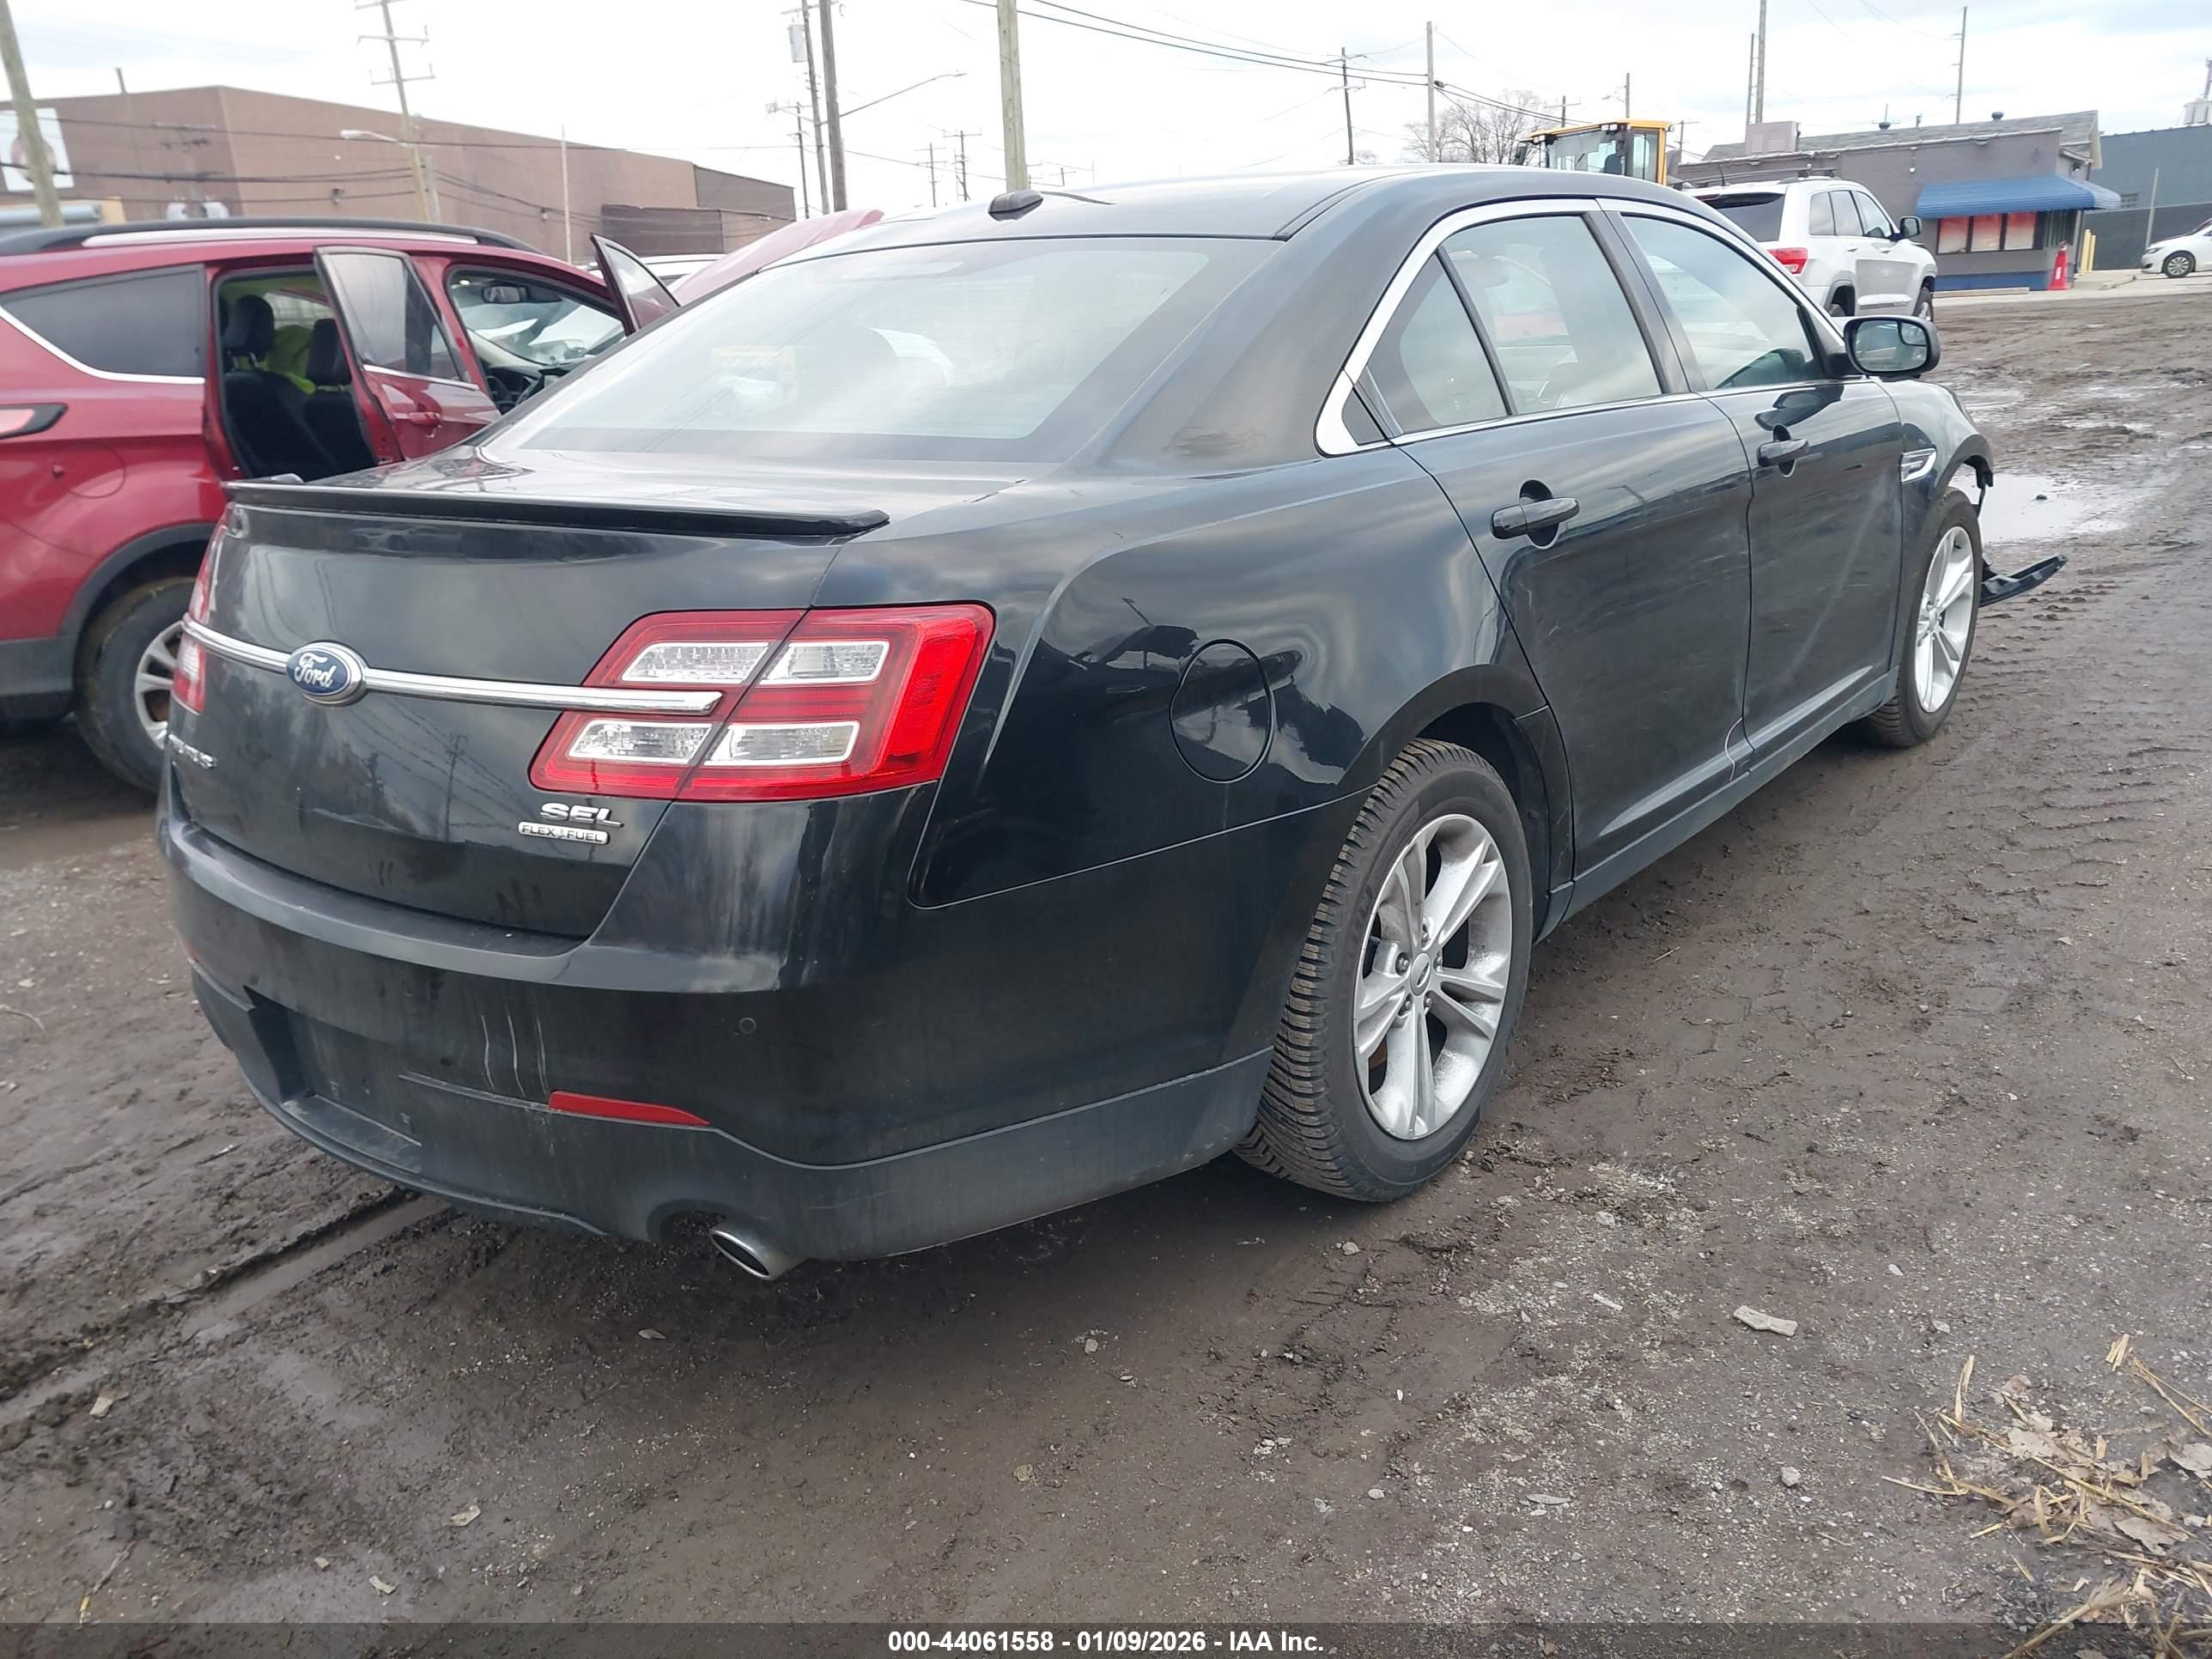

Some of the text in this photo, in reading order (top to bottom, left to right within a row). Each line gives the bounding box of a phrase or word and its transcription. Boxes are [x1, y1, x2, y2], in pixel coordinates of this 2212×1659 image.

[294, 653, 337, 688] Ford
[539, 802, 623, 828] SEL
[521, 824, 603, 842] FLEX FUEL
